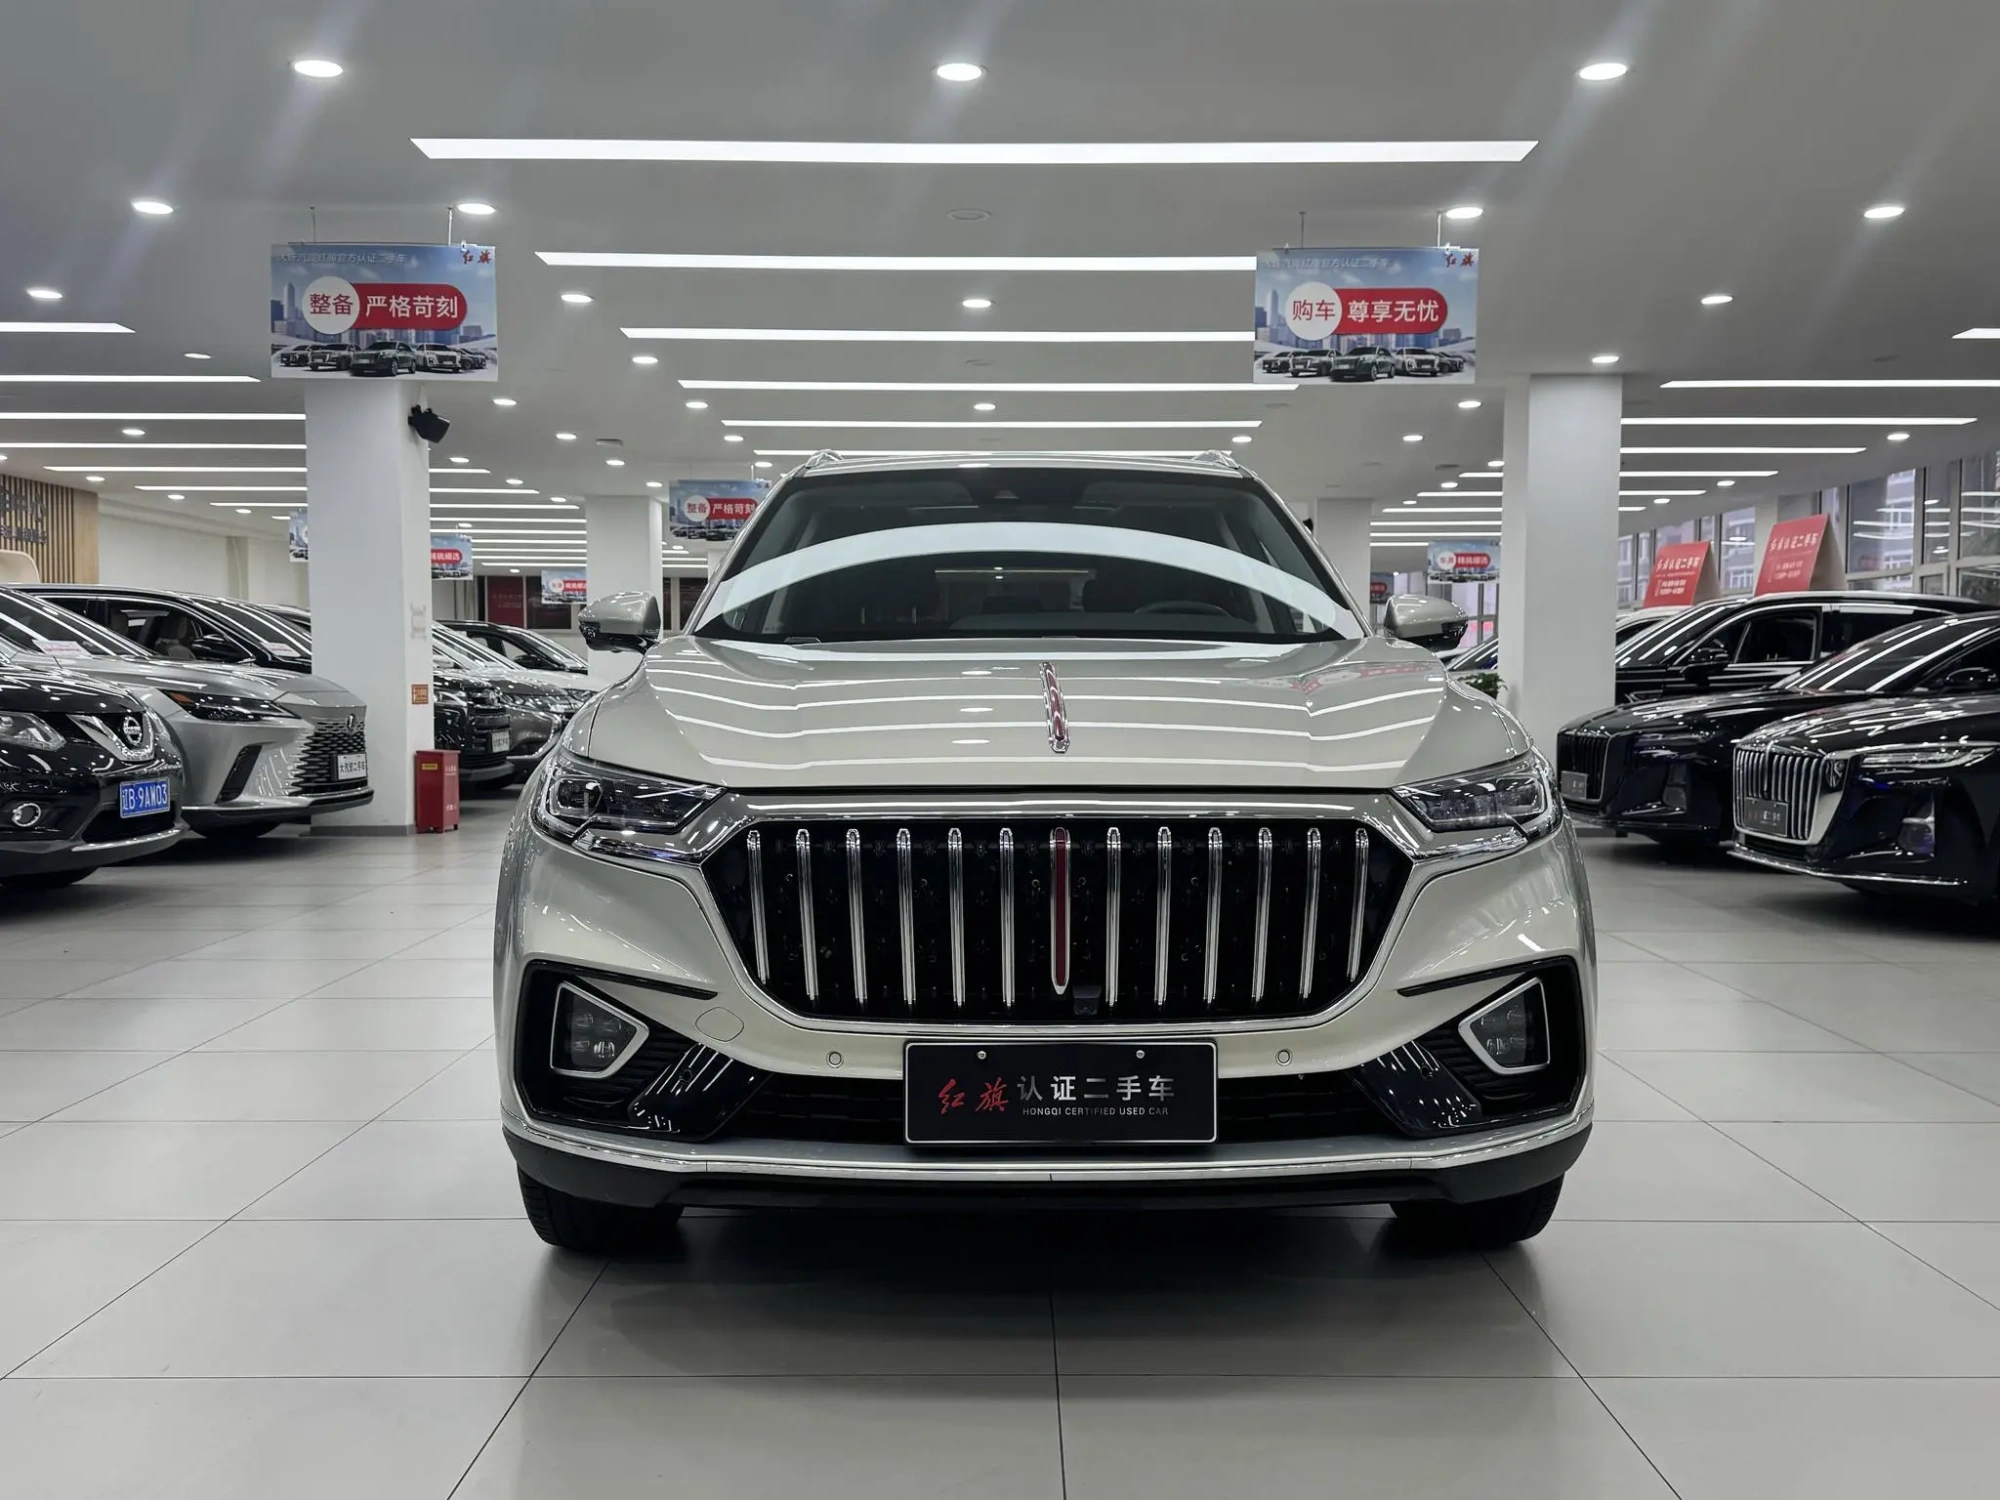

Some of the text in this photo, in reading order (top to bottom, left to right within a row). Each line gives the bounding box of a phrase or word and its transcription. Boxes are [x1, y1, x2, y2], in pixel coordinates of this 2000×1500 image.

[461, 250, 492, 264] 红旗
[1444, 253, 1475, 268] 红旗
[309, 293, 458, 319] 整备 严格苛刻
[1292, 299, 1440, 323] 购车 尊享无忧
[1016, 1075, 1175, 1101] 认证二手车
[1022, 1107, 1169, 1116] HONGQI CERTIFIED USED CAR
